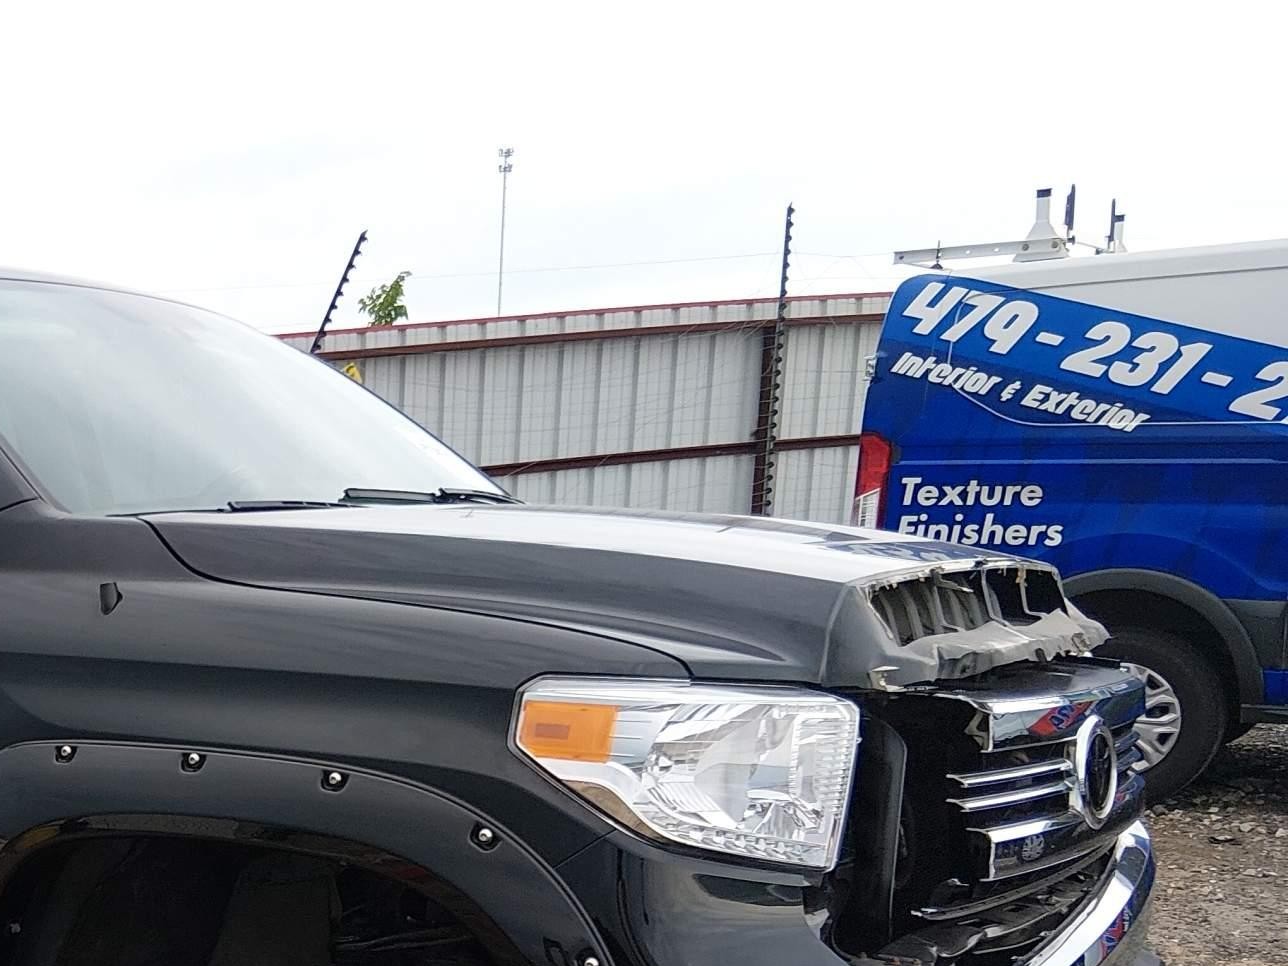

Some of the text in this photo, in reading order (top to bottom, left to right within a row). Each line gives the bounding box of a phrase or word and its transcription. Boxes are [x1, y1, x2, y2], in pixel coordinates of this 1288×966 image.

[903, 281, 1039, 355] 479
[1060, 321, 1213, 395] 231
[1228, 361, 1288, 423] 2
[890, 351, 1152, 432] Interior & Exterior
[901, 477, 1043, 506] Texture
[897, 512, 1063, 546] Finishers
